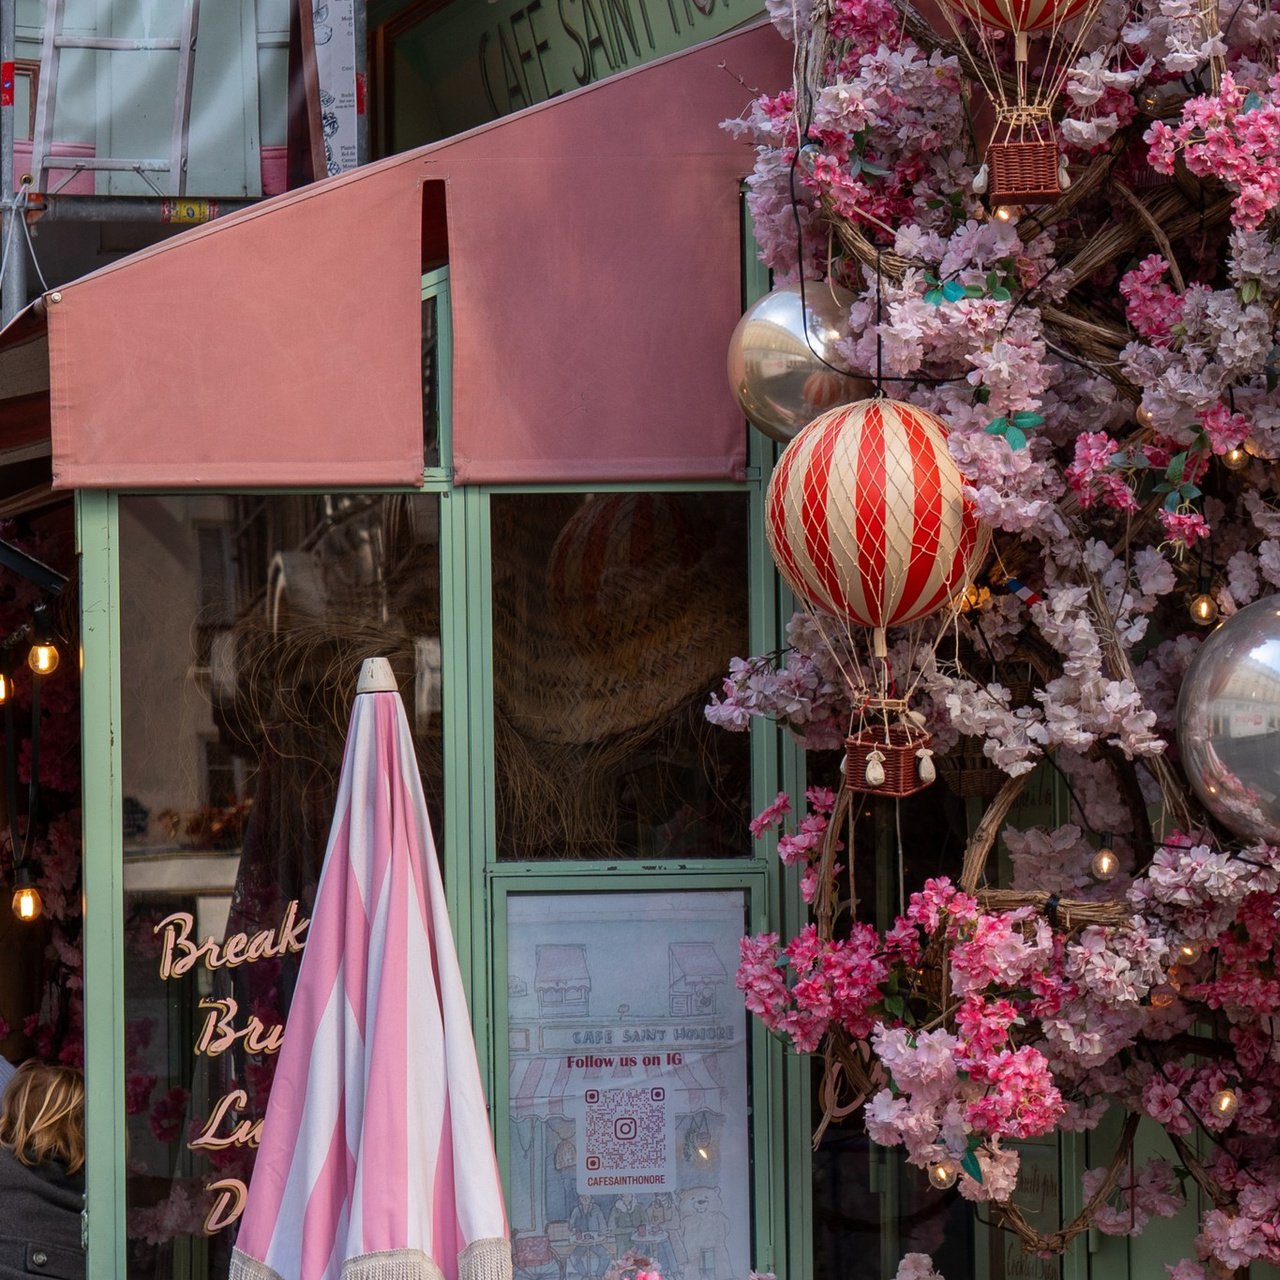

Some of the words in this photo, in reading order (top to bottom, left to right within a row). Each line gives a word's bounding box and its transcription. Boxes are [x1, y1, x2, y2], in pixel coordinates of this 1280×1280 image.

[573, 1029, 613, 1045] CAFE
[622, 1029, 666, 1043] SAINT
[567, 1055, 614, 1069] Follow
[620, 1056, 637, 1067] us
[642, 1056, 661, 1066] on
[666, 1052, 682, 1066] IG
[587, 1175, 666, 1187] CAFESAINTHONORE
